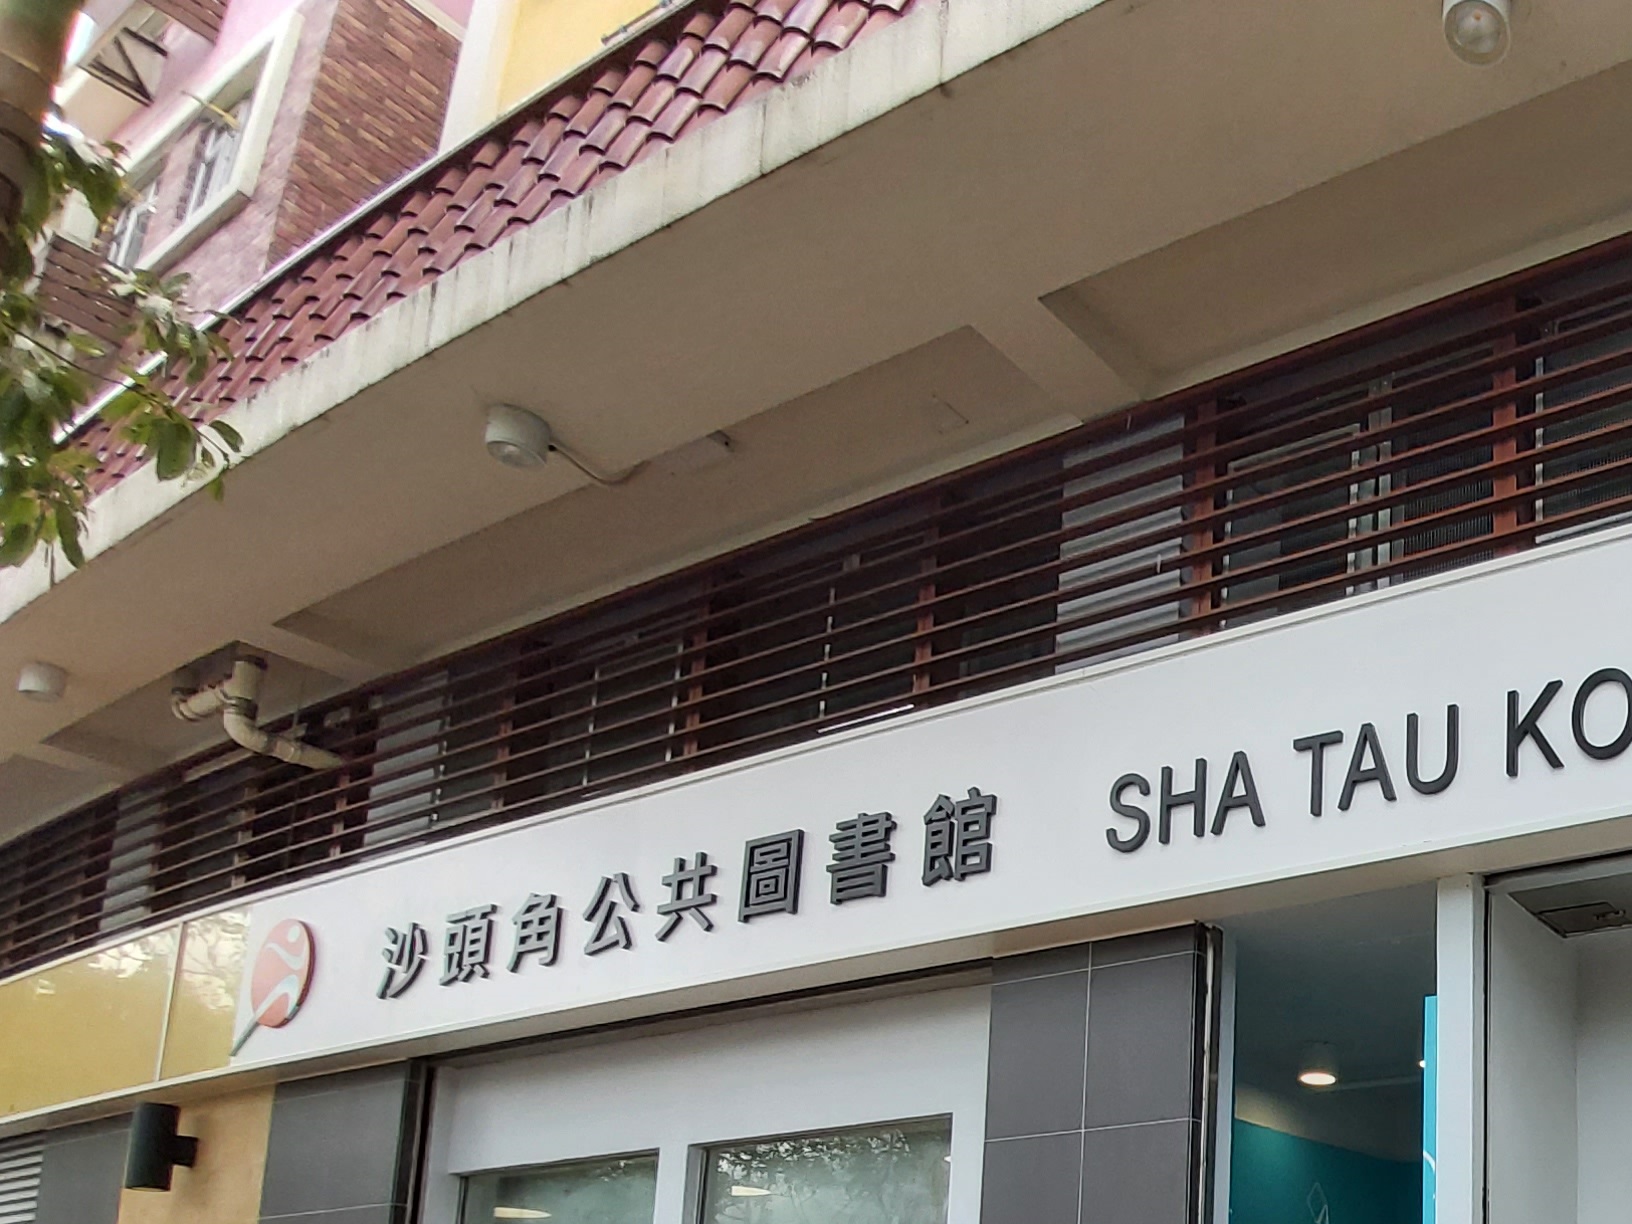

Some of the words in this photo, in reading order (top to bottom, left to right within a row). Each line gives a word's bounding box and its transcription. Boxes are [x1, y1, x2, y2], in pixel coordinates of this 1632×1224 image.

[1107, 751, 1266, 853] SHA
[1294, 704, 1460, 817] TAU
[376, 787, 998, 1000] 沙頭角公共圖書館
